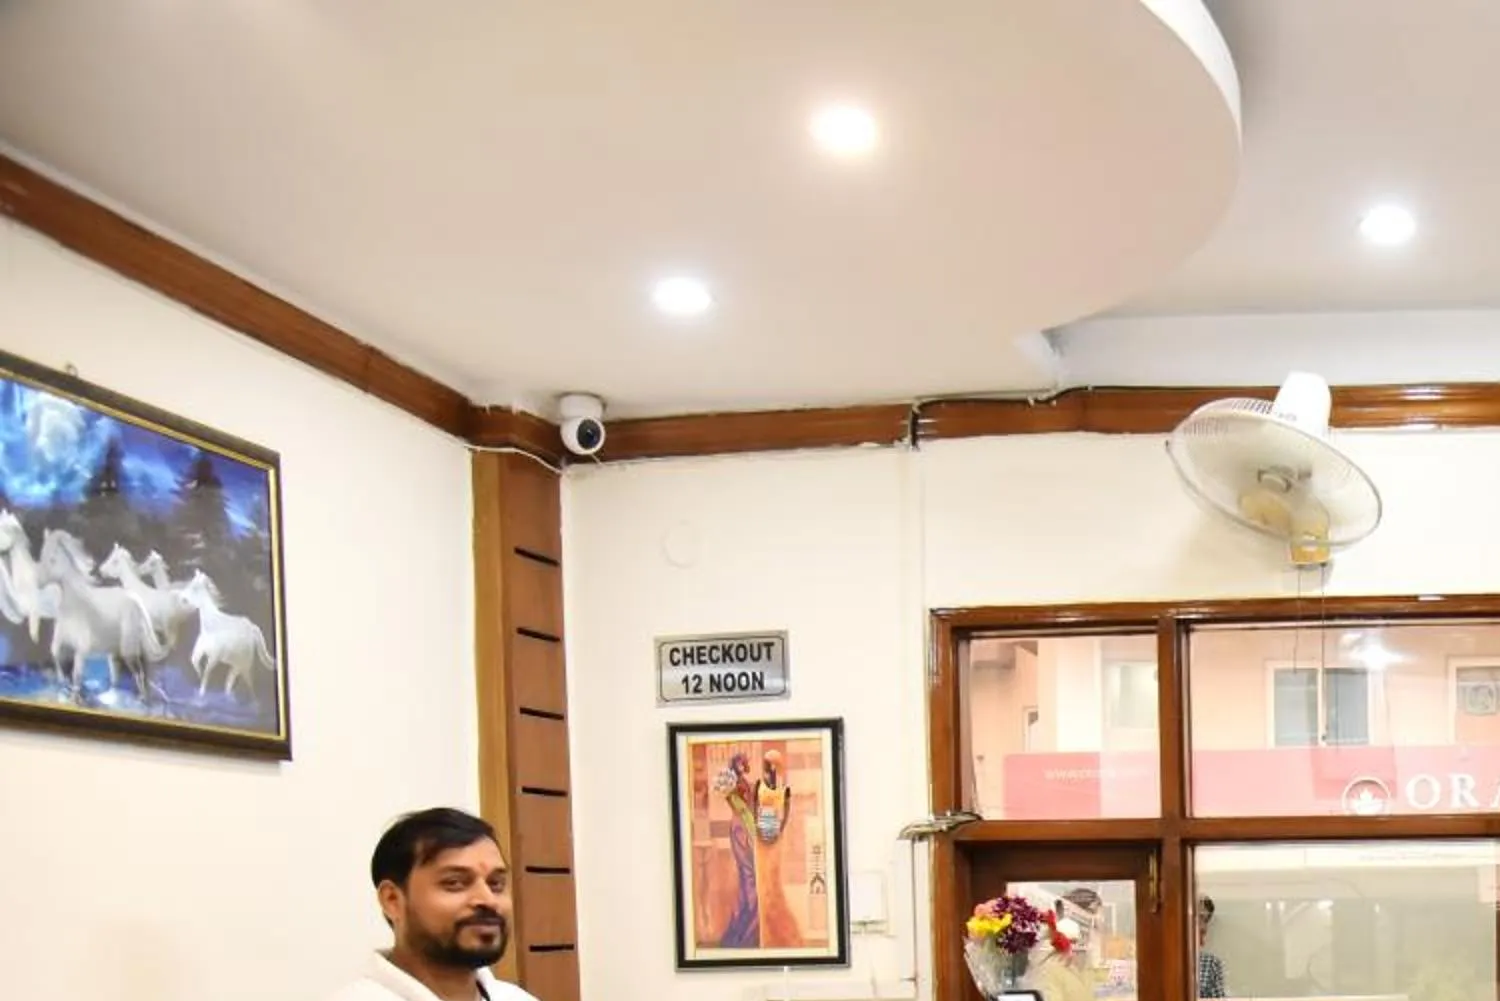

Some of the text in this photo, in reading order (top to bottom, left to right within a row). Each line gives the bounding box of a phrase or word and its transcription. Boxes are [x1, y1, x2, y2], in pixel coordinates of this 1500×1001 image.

[669, 641, 774, 666] CHECKOUT
[681, 671, 765, 695] 12 NOON
